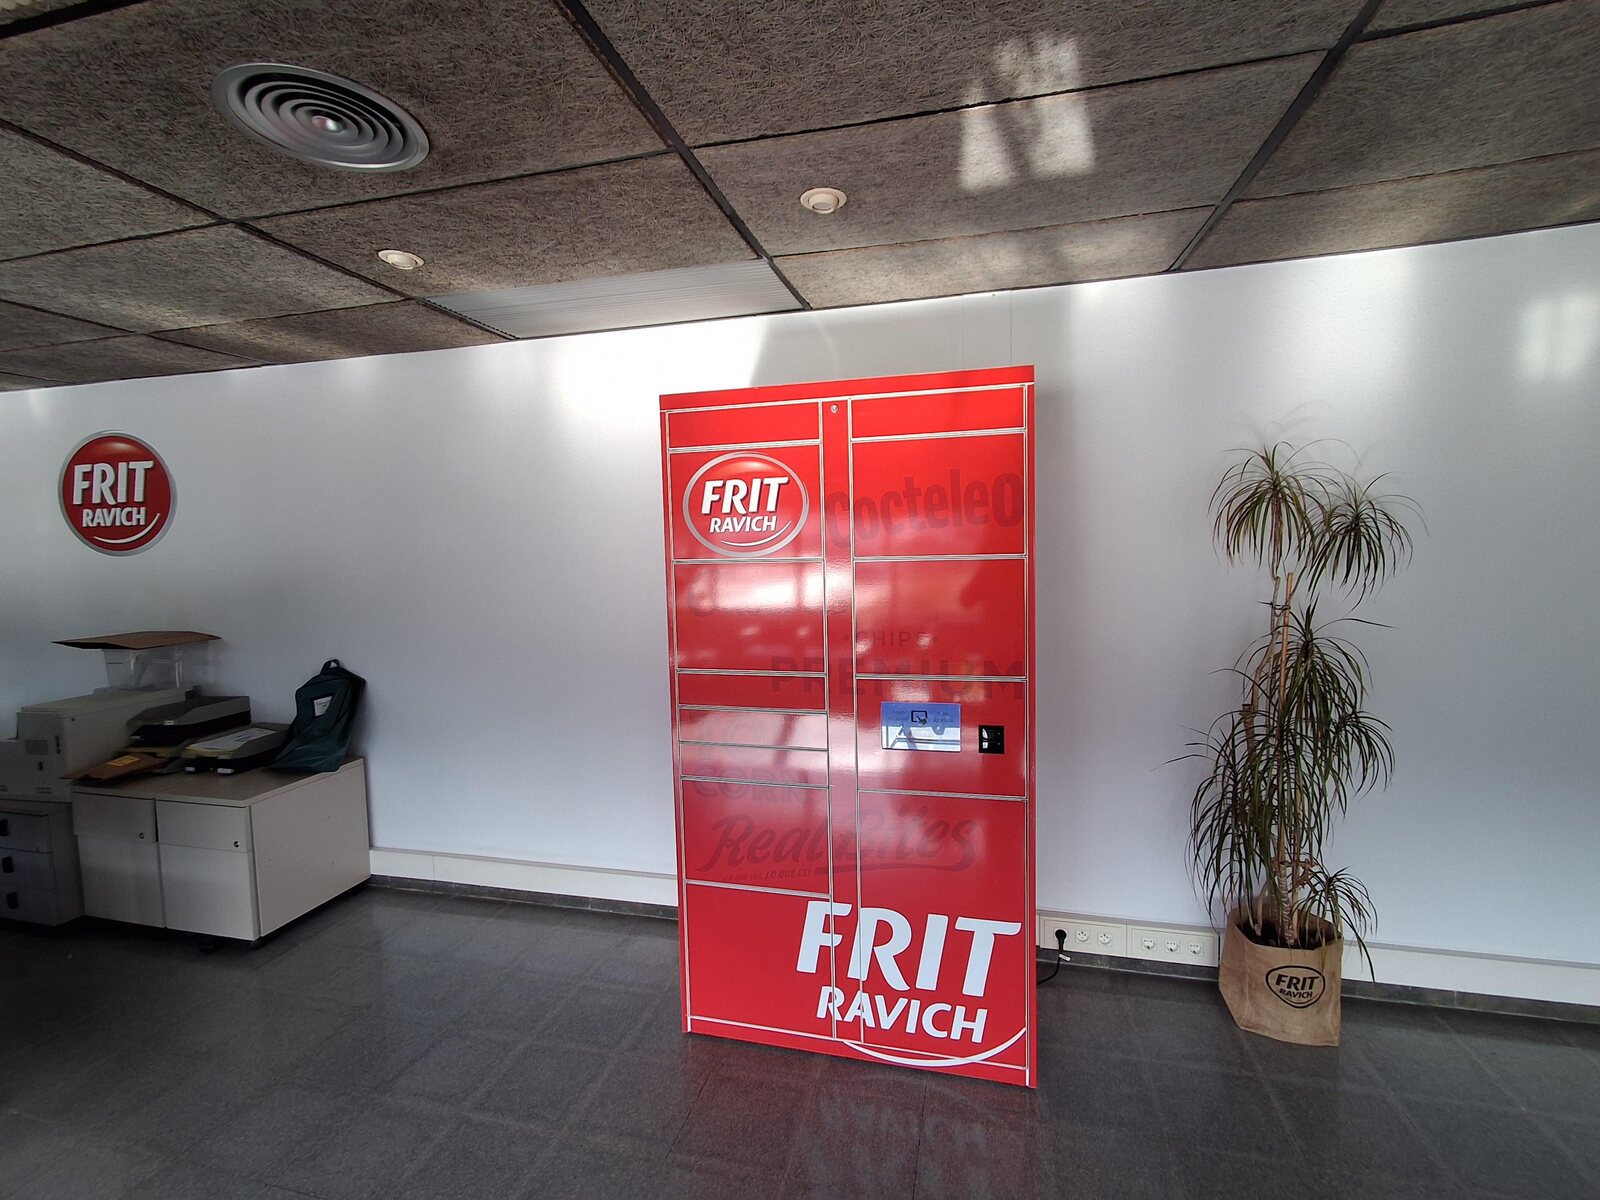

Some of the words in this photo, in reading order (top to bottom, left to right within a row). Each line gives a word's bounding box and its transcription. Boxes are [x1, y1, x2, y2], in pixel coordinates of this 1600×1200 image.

[72, 460, 155, 506] FRIT
[701, 476, 790, 515] FRIT
[82, 506, 146, 528] RAVICH
[709, 515, 778, 534] RAVICH
[770, 656, 1023, 701] PREMIUM
[696, 813, 833, 873] Real
[796, 900, 1022, 997] FRIT
[1275, 973, 1319, 991] FRIT
[1279, 988, 1313, 999] RAVICH
[816, 985, 988, 1043] RAVICH
